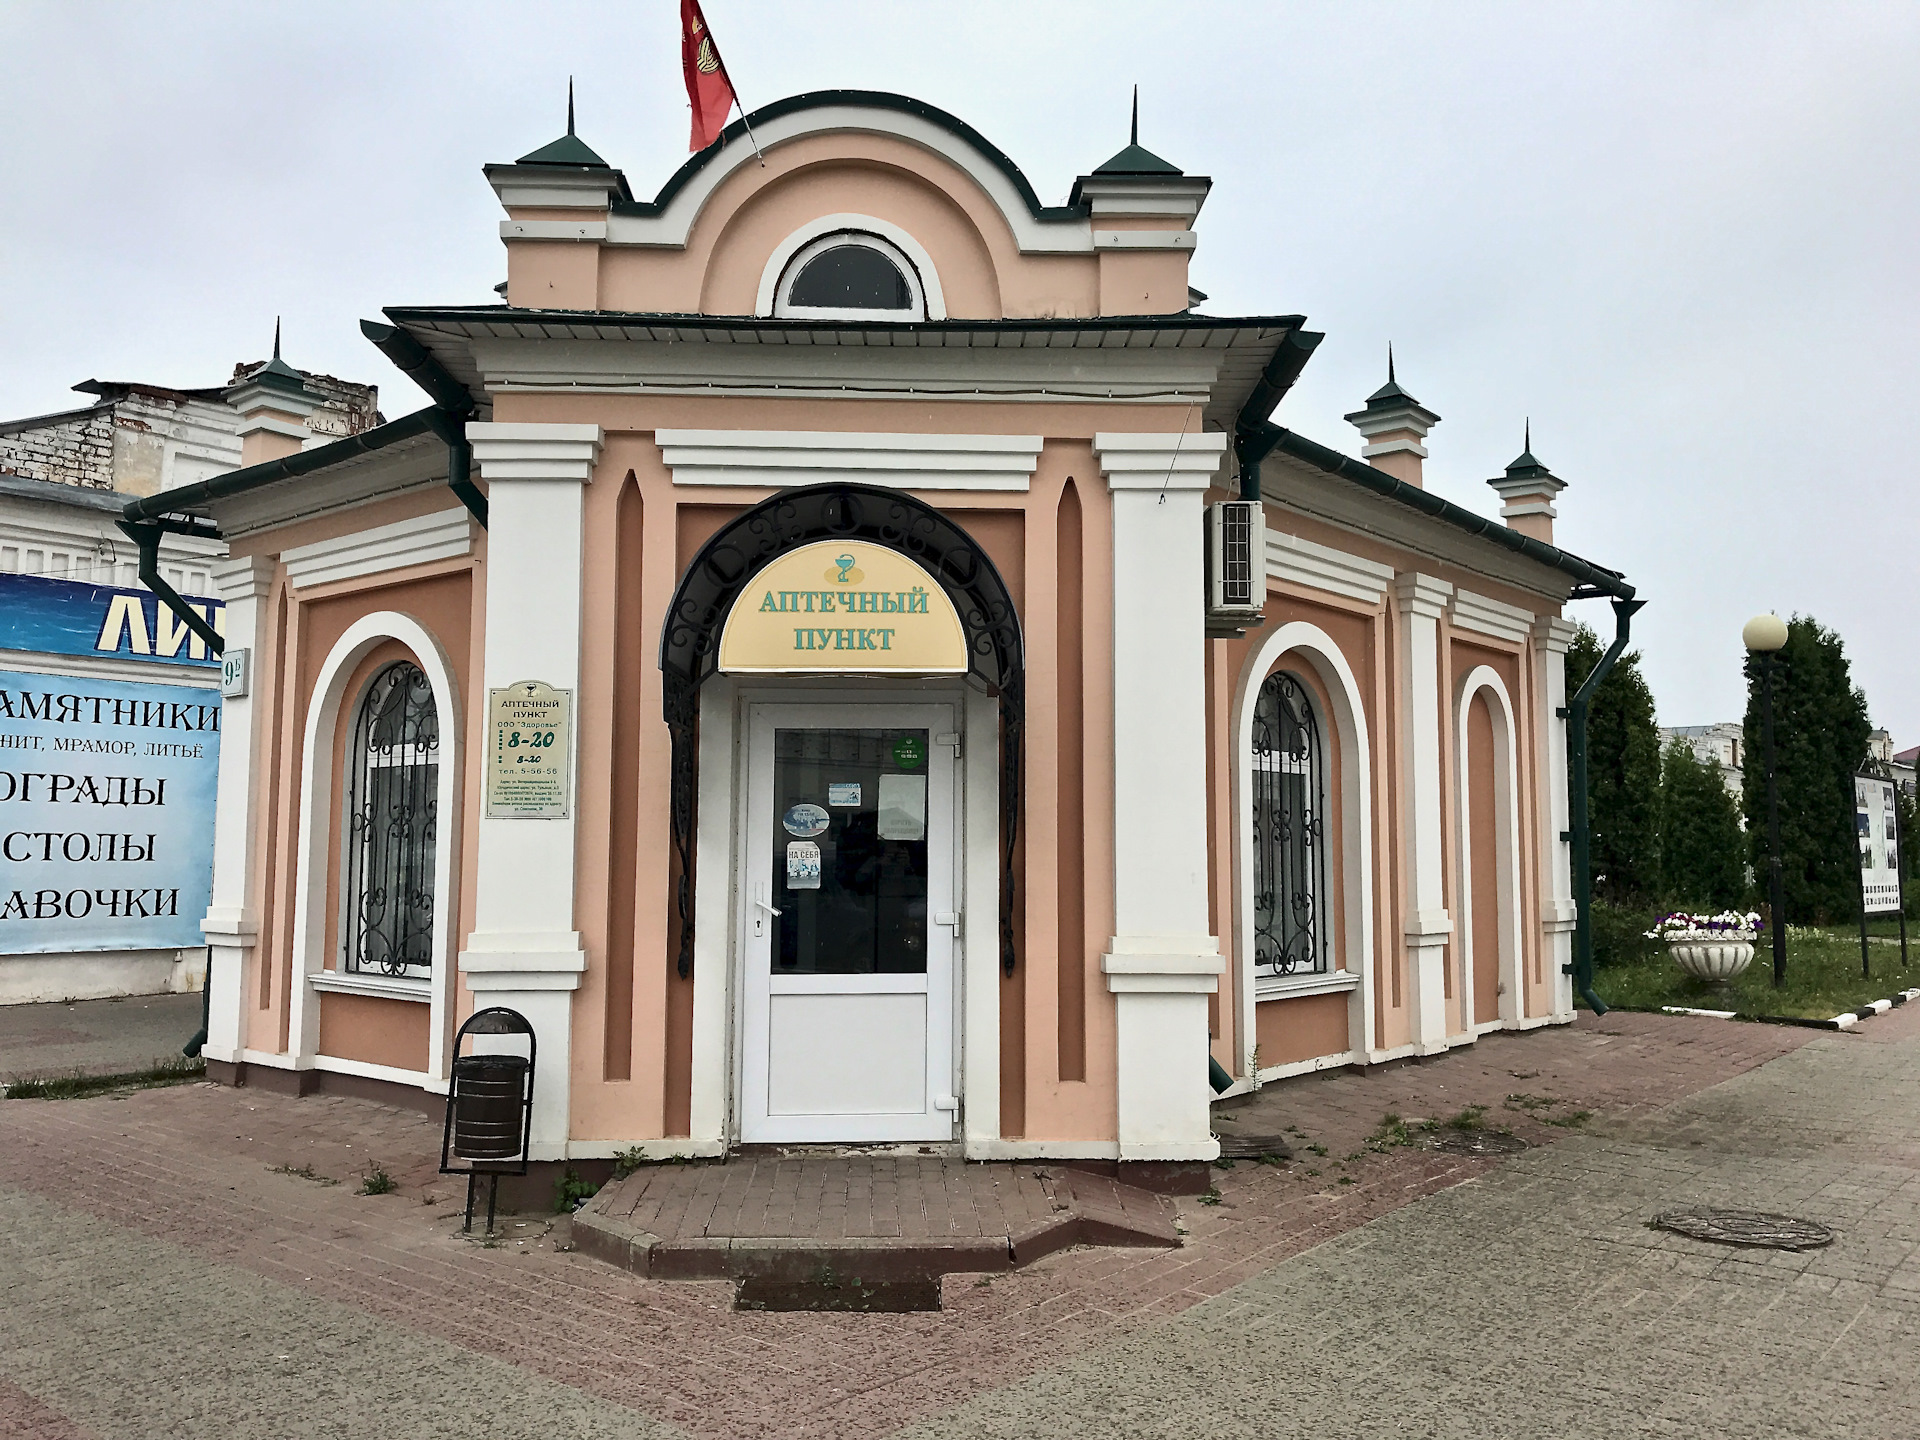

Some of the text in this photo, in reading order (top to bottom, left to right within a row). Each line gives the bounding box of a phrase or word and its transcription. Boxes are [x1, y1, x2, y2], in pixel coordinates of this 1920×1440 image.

[758, 586, 930, 614] АПТЕЧНЫЙ
[793, 628, 895, 651] ПУНКТ
[501, 699, 560, 709] АПТЕЧНЫЙ
[513, 711, 548, 719] ПУНКТ
[53, 737, 137, 757] МРАМОР,
[144, 742, 204, 760] ЛИТЬЁ
[507, 731, 555, 748] 8-20
[516, 755, 542, 764] 8-20
[0, 771, 167, 808] ОГРАДЫ
[2, 831, 157, 863] СТОЛЫ
[789, 850, 819, 859] НА СЕБЯ
[0, 888, 181, 921] АВОЧКИ
